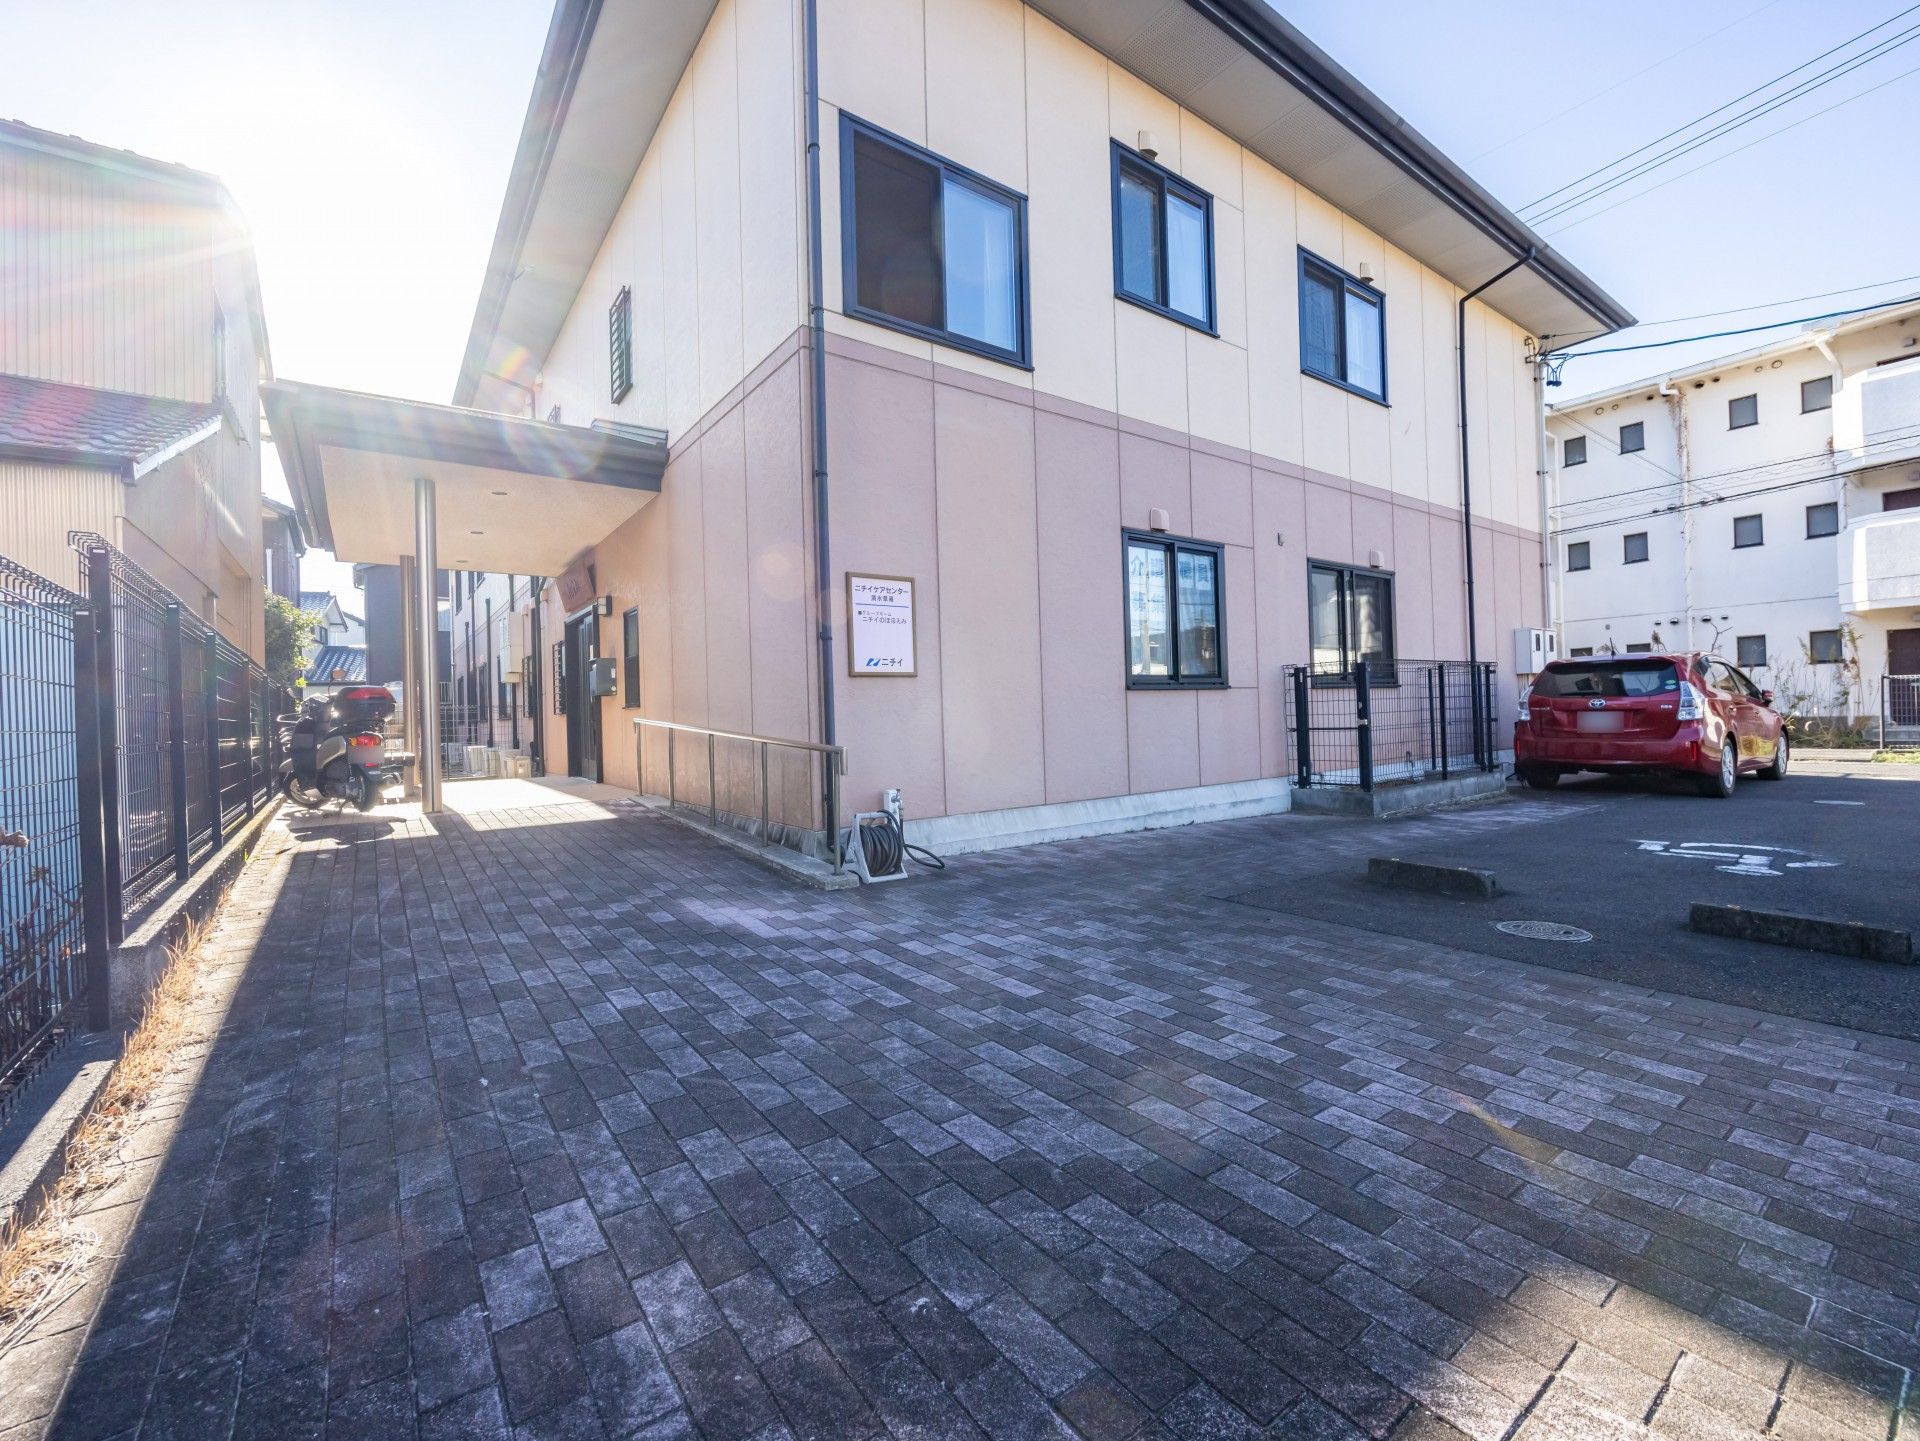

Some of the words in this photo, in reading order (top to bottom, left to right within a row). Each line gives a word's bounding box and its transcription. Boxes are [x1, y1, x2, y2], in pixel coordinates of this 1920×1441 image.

[854, 585, 909, 595] ニチイケアセンター
[881, 657, 903, 667] ニチイ
